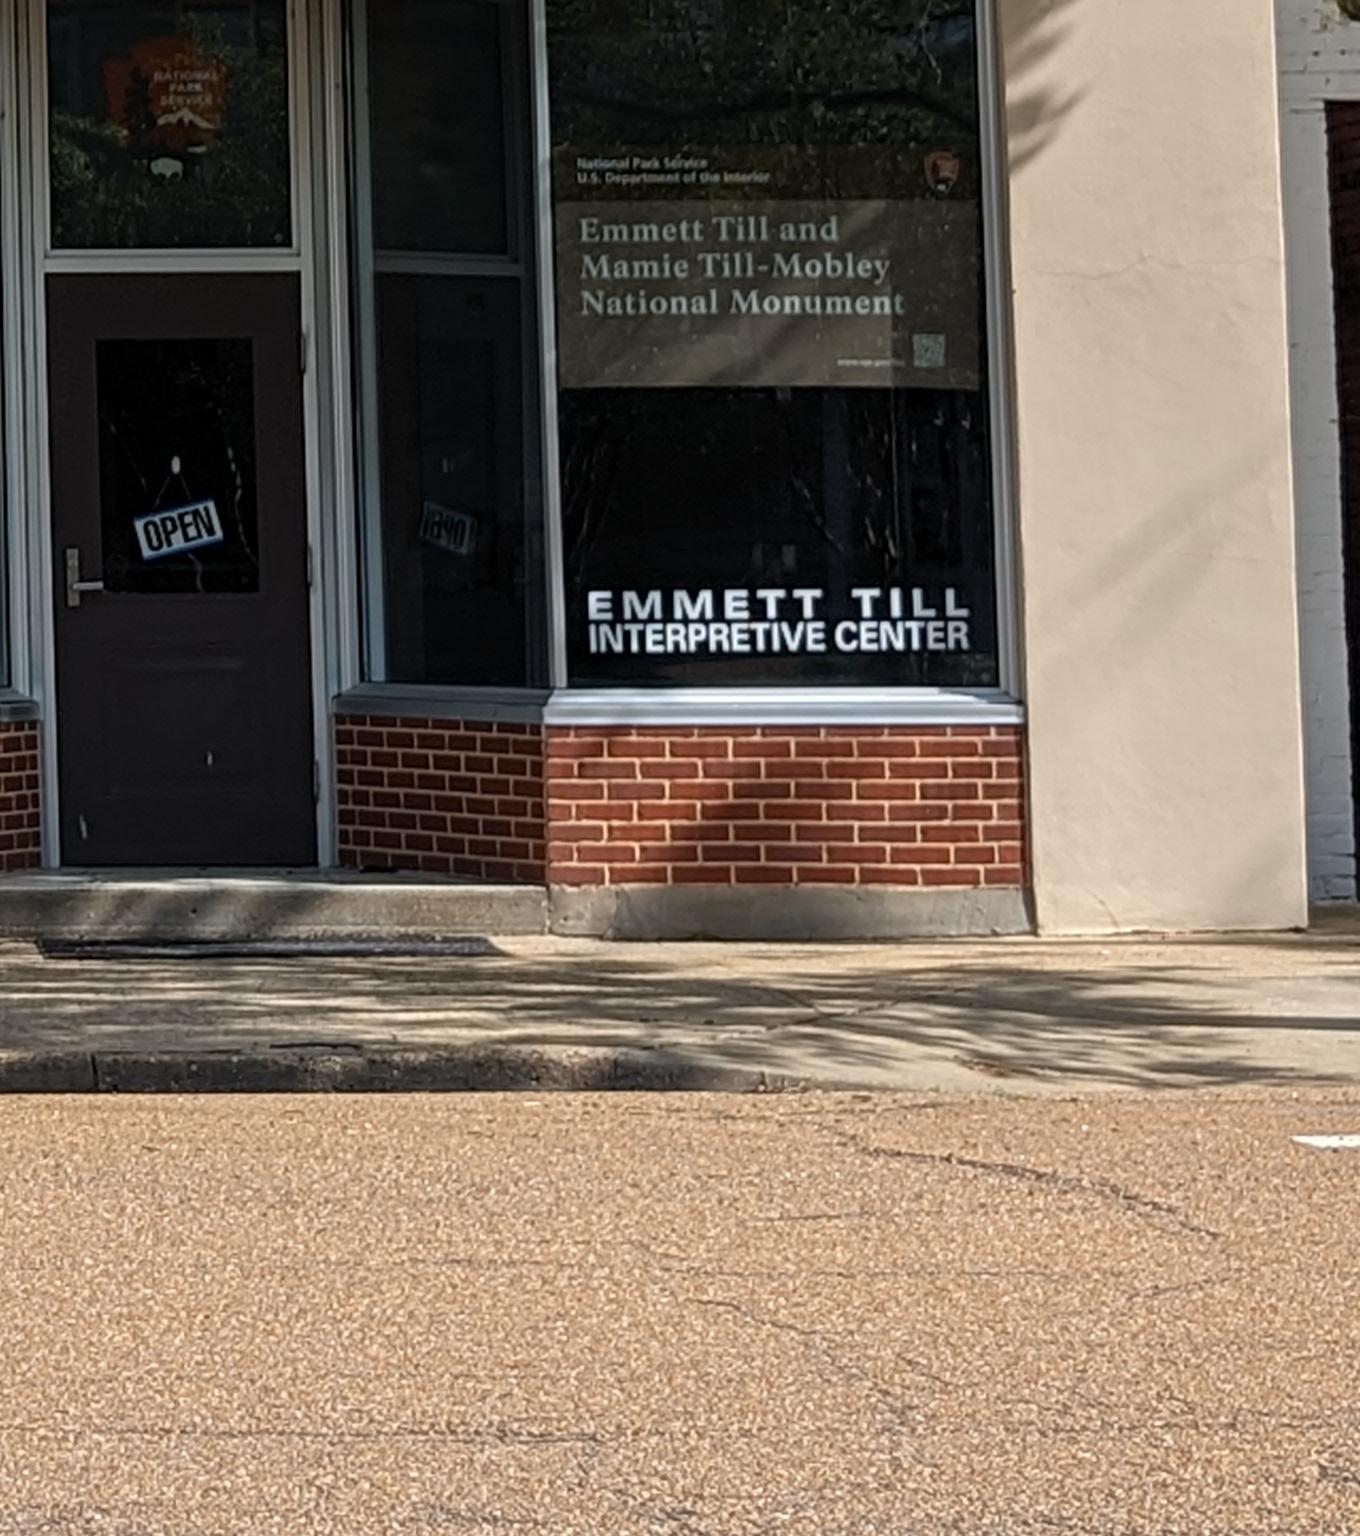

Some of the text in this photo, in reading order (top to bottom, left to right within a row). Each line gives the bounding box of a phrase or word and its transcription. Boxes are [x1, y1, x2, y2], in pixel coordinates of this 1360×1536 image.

[576, 157, 708, 169] National Park Service
[682, 171, 697, 184] of
[579, 215, 839, 243] Emmett Till and
[579, 252, 890, 286] Mamie Till-Mobley
[581, 289, 905, 316] National Monument
[143, 505, 216, 552] OPEN
[587, 586, 970, 621] EMMETT TILL
[588, 619, 970, 654] INTERPRETIVE CENTER
